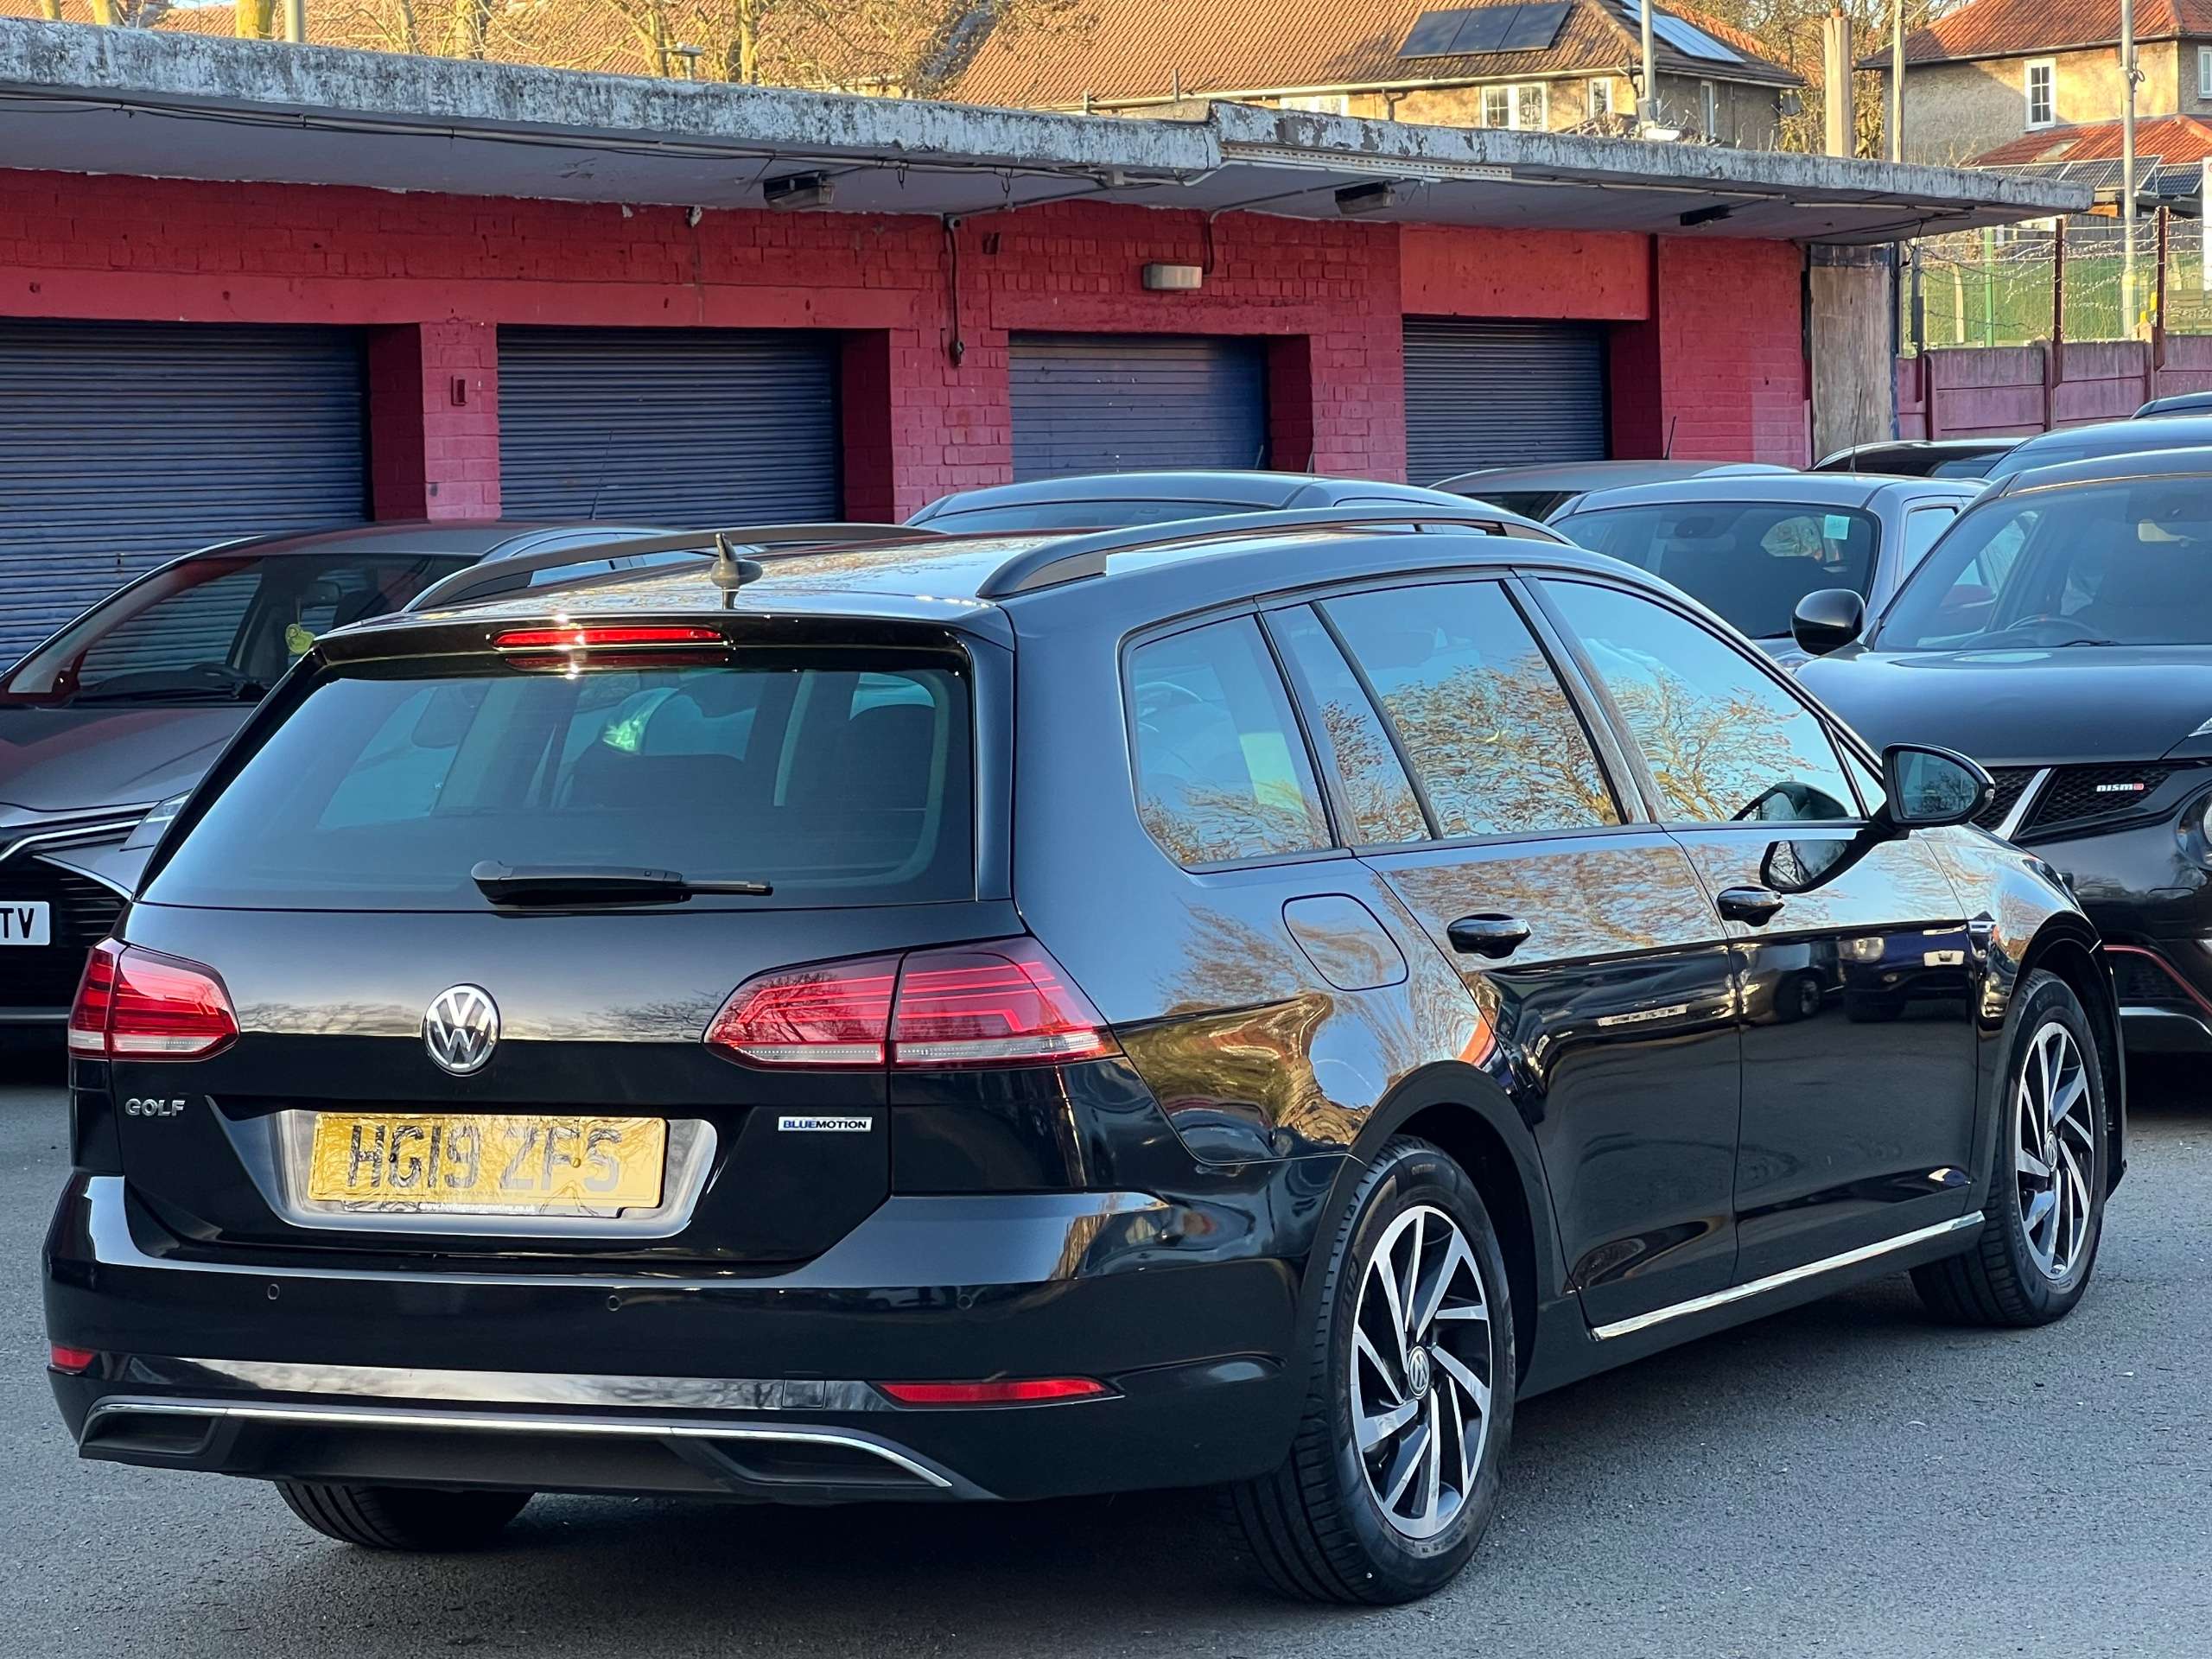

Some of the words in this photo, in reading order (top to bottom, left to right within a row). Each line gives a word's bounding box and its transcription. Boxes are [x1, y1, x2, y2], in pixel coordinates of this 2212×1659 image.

[0, 908, 35, 939] TV
[424, 984, 499, 1075] VW
[125, 1098, 186, 1116] GOLF
[783, 1120, 868, 1128] BLUEMOTION
[347, 1124, 480, 1188] HG19
[499, 1127, 623, 1192] ZFS
